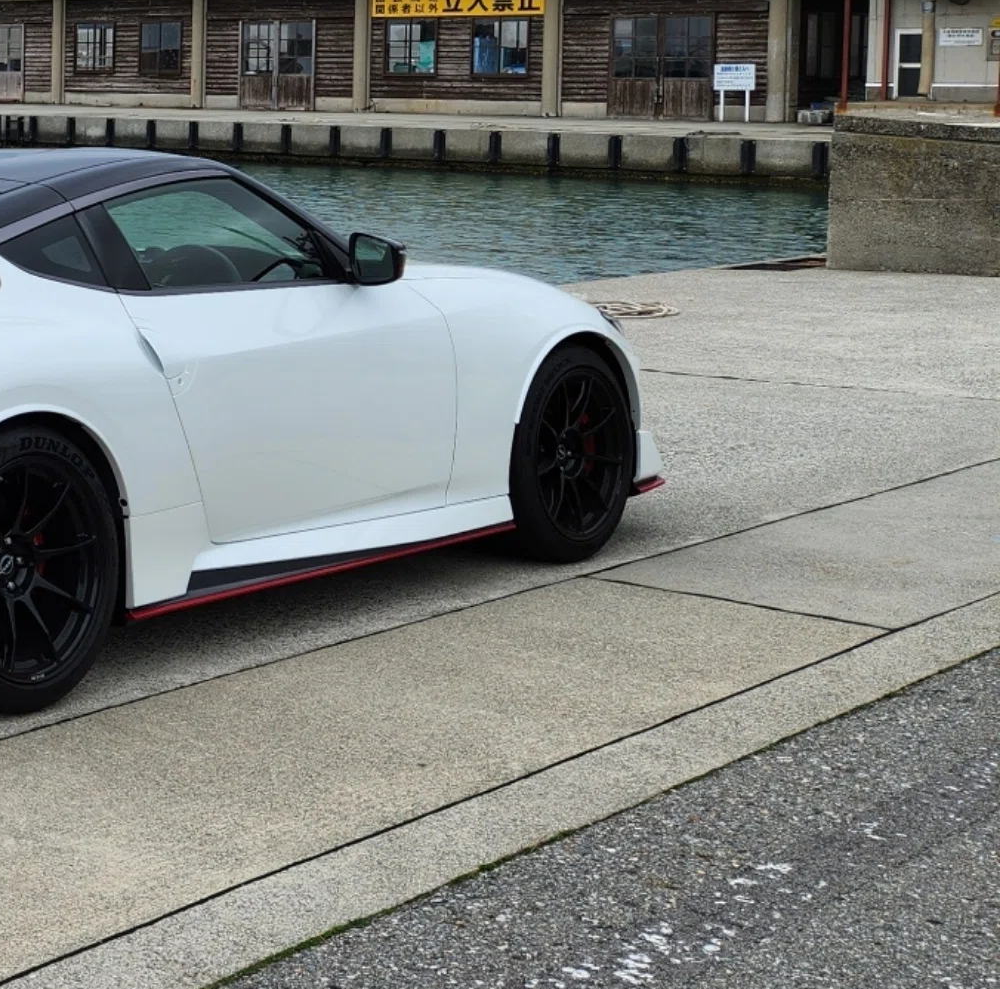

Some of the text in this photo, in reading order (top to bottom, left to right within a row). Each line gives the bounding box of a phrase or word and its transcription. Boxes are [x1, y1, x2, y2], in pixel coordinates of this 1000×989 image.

[375, 3, 439, 15] 関係者以外
[19, 436, 97, 479] DUNLOP
